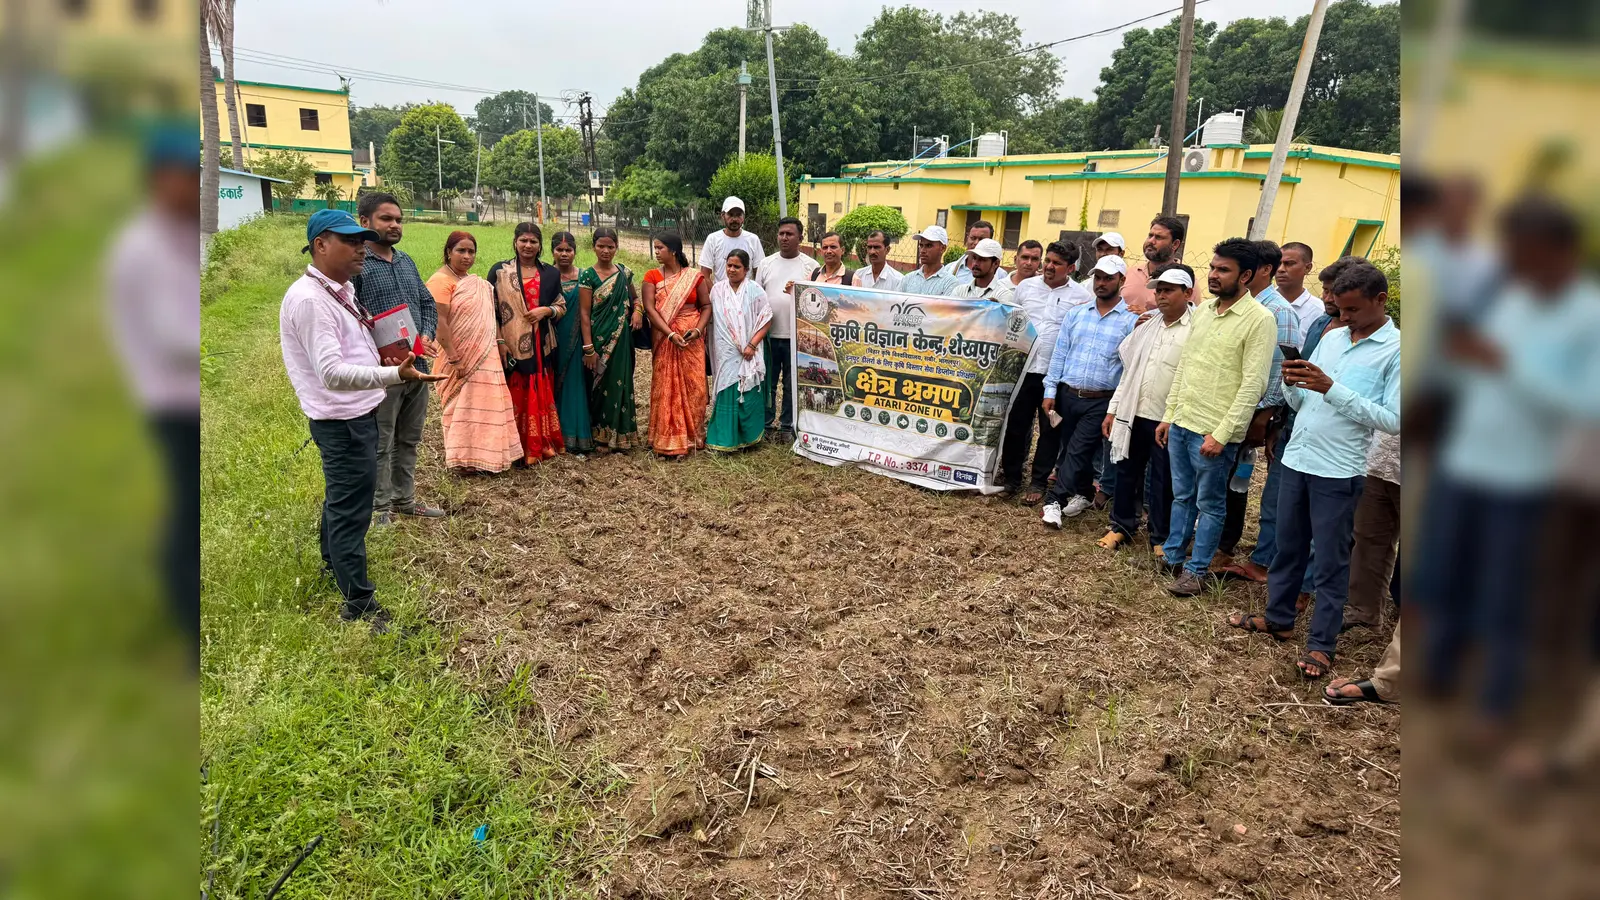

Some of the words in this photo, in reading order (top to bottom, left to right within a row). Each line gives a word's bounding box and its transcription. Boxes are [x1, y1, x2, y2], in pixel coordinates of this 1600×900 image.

[830, 320, 860, 346] कृषि
[864, 322, 909, 348] विज्ञान
[949, 332, 1001, 368] शेखपुरा
[856, 368, 897, 396] क्षेत्र
[902, 380, 962, 408] भ्रमण
[874, 398, 901, 410] ATARI
[904, 404, 930, 416] ZONE
[933, 409, 943, 418] IV
[817, 443, 839, 454] शेखपुरा
[868, 451, 881, 464] T.P.
[906, 461, 928, 473] 3374
